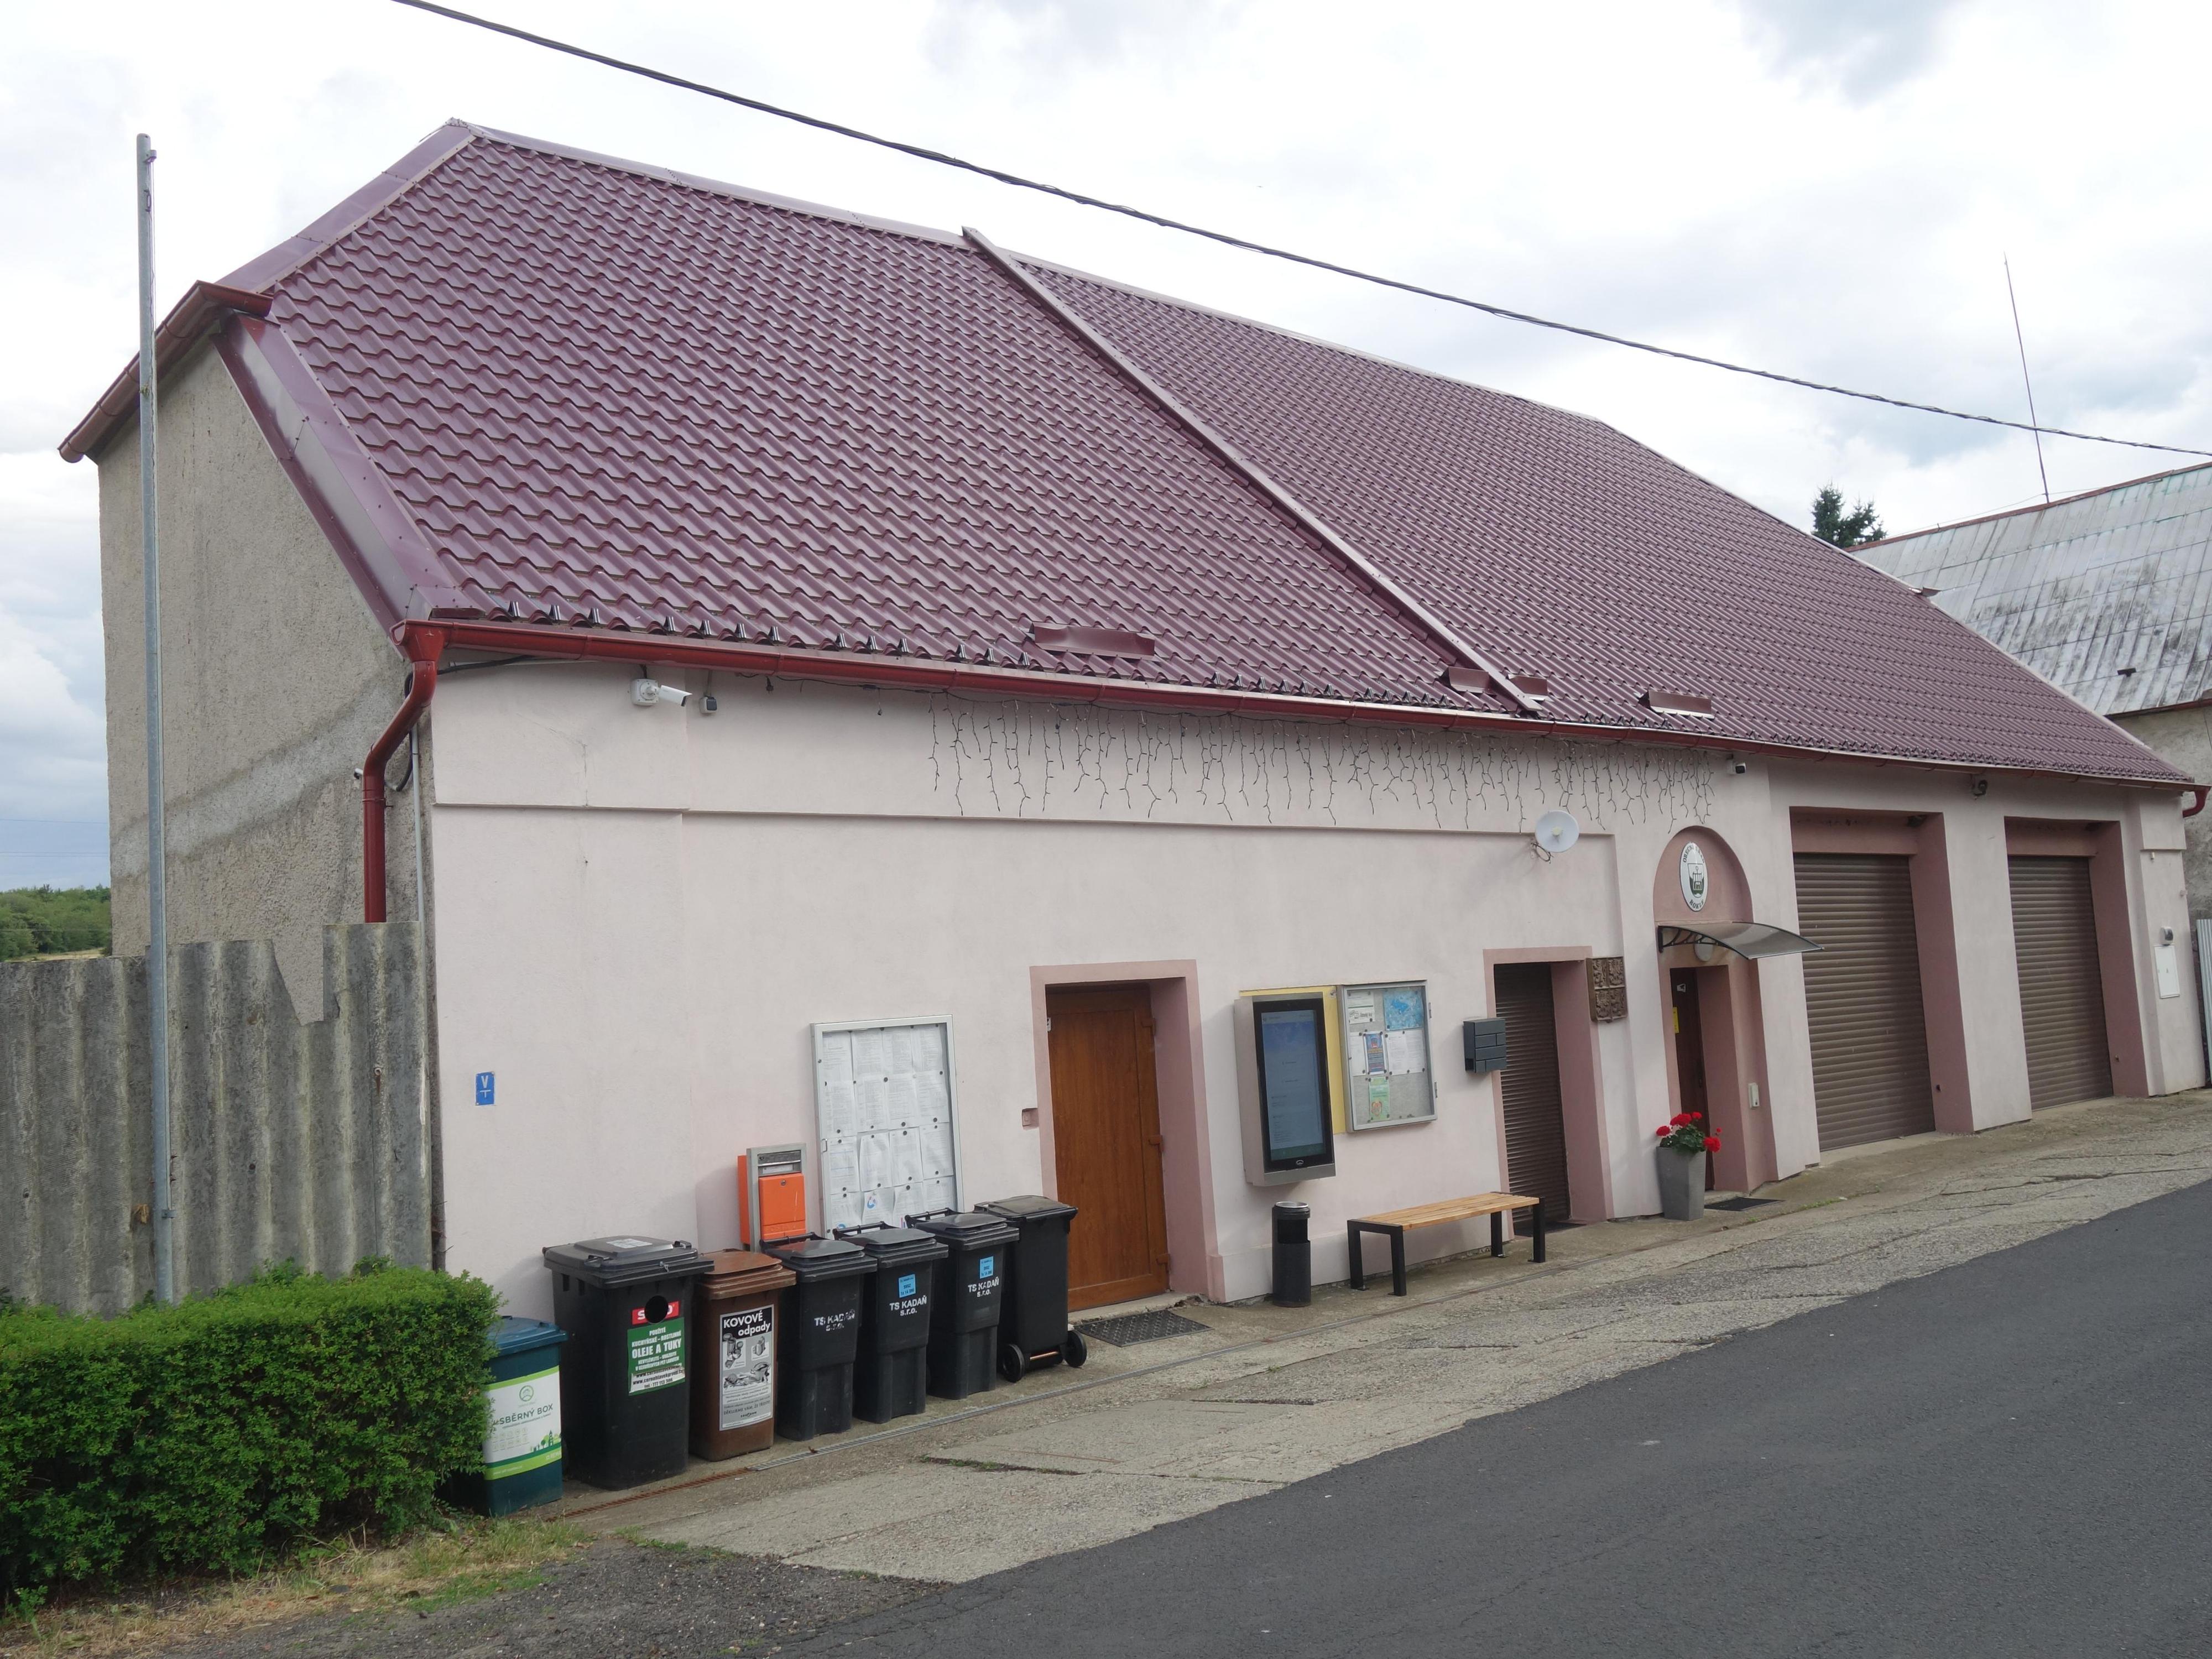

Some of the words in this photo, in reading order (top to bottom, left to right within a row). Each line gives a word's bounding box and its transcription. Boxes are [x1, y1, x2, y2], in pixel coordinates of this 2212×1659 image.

[968, 1284, 977, 1293] TS
[978, 1276, 999, 1291] KADAŇ
[977, 1289, 992, 1297] s.r.o.
[889, 1302, 900, 1311] TS
[901, 1295, 927, 1309] KADAŇ
[723, 1310, 763, 1328] KOVOVÉ
[900, 1307, 917, 1316] s.r.o.
[738, 1321, 771, 1336] odpady
[814, 1317, 825, 1326] TS
[632, 1345, 654, 1359] OLEJE
[656, 1344, 661, 1354] A
[664, 1338, 681, 1352] TUKY
[499, 1408, 535, 1425] SBĚRNÝ
[537, 1404, 553, 1415] BOX
